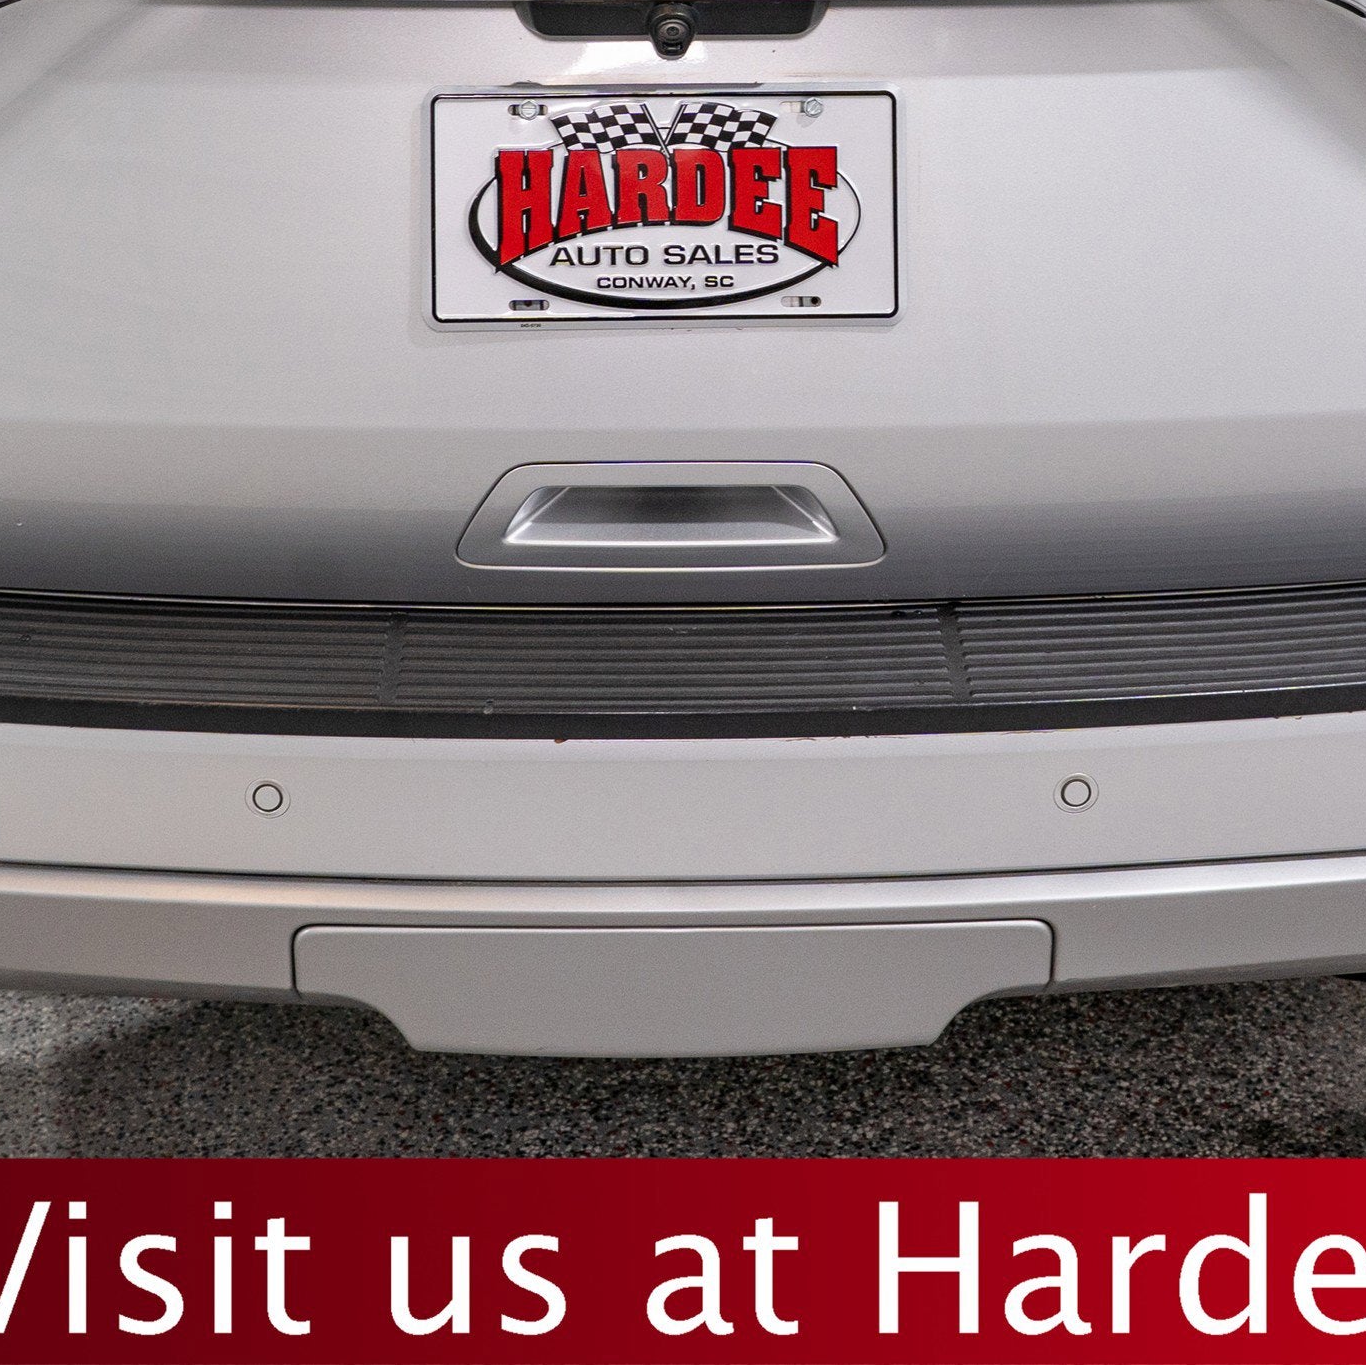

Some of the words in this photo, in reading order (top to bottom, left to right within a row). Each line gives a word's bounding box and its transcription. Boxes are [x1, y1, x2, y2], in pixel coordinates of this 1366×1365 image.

[495, 146, 839, 271] HARDEE
[549, 244, 649, 267] AUTO
[663, 244, 779, 266] SALES
[596, 275, 696, 291] CONWAY,
[704, 275, 734, 289] SC
